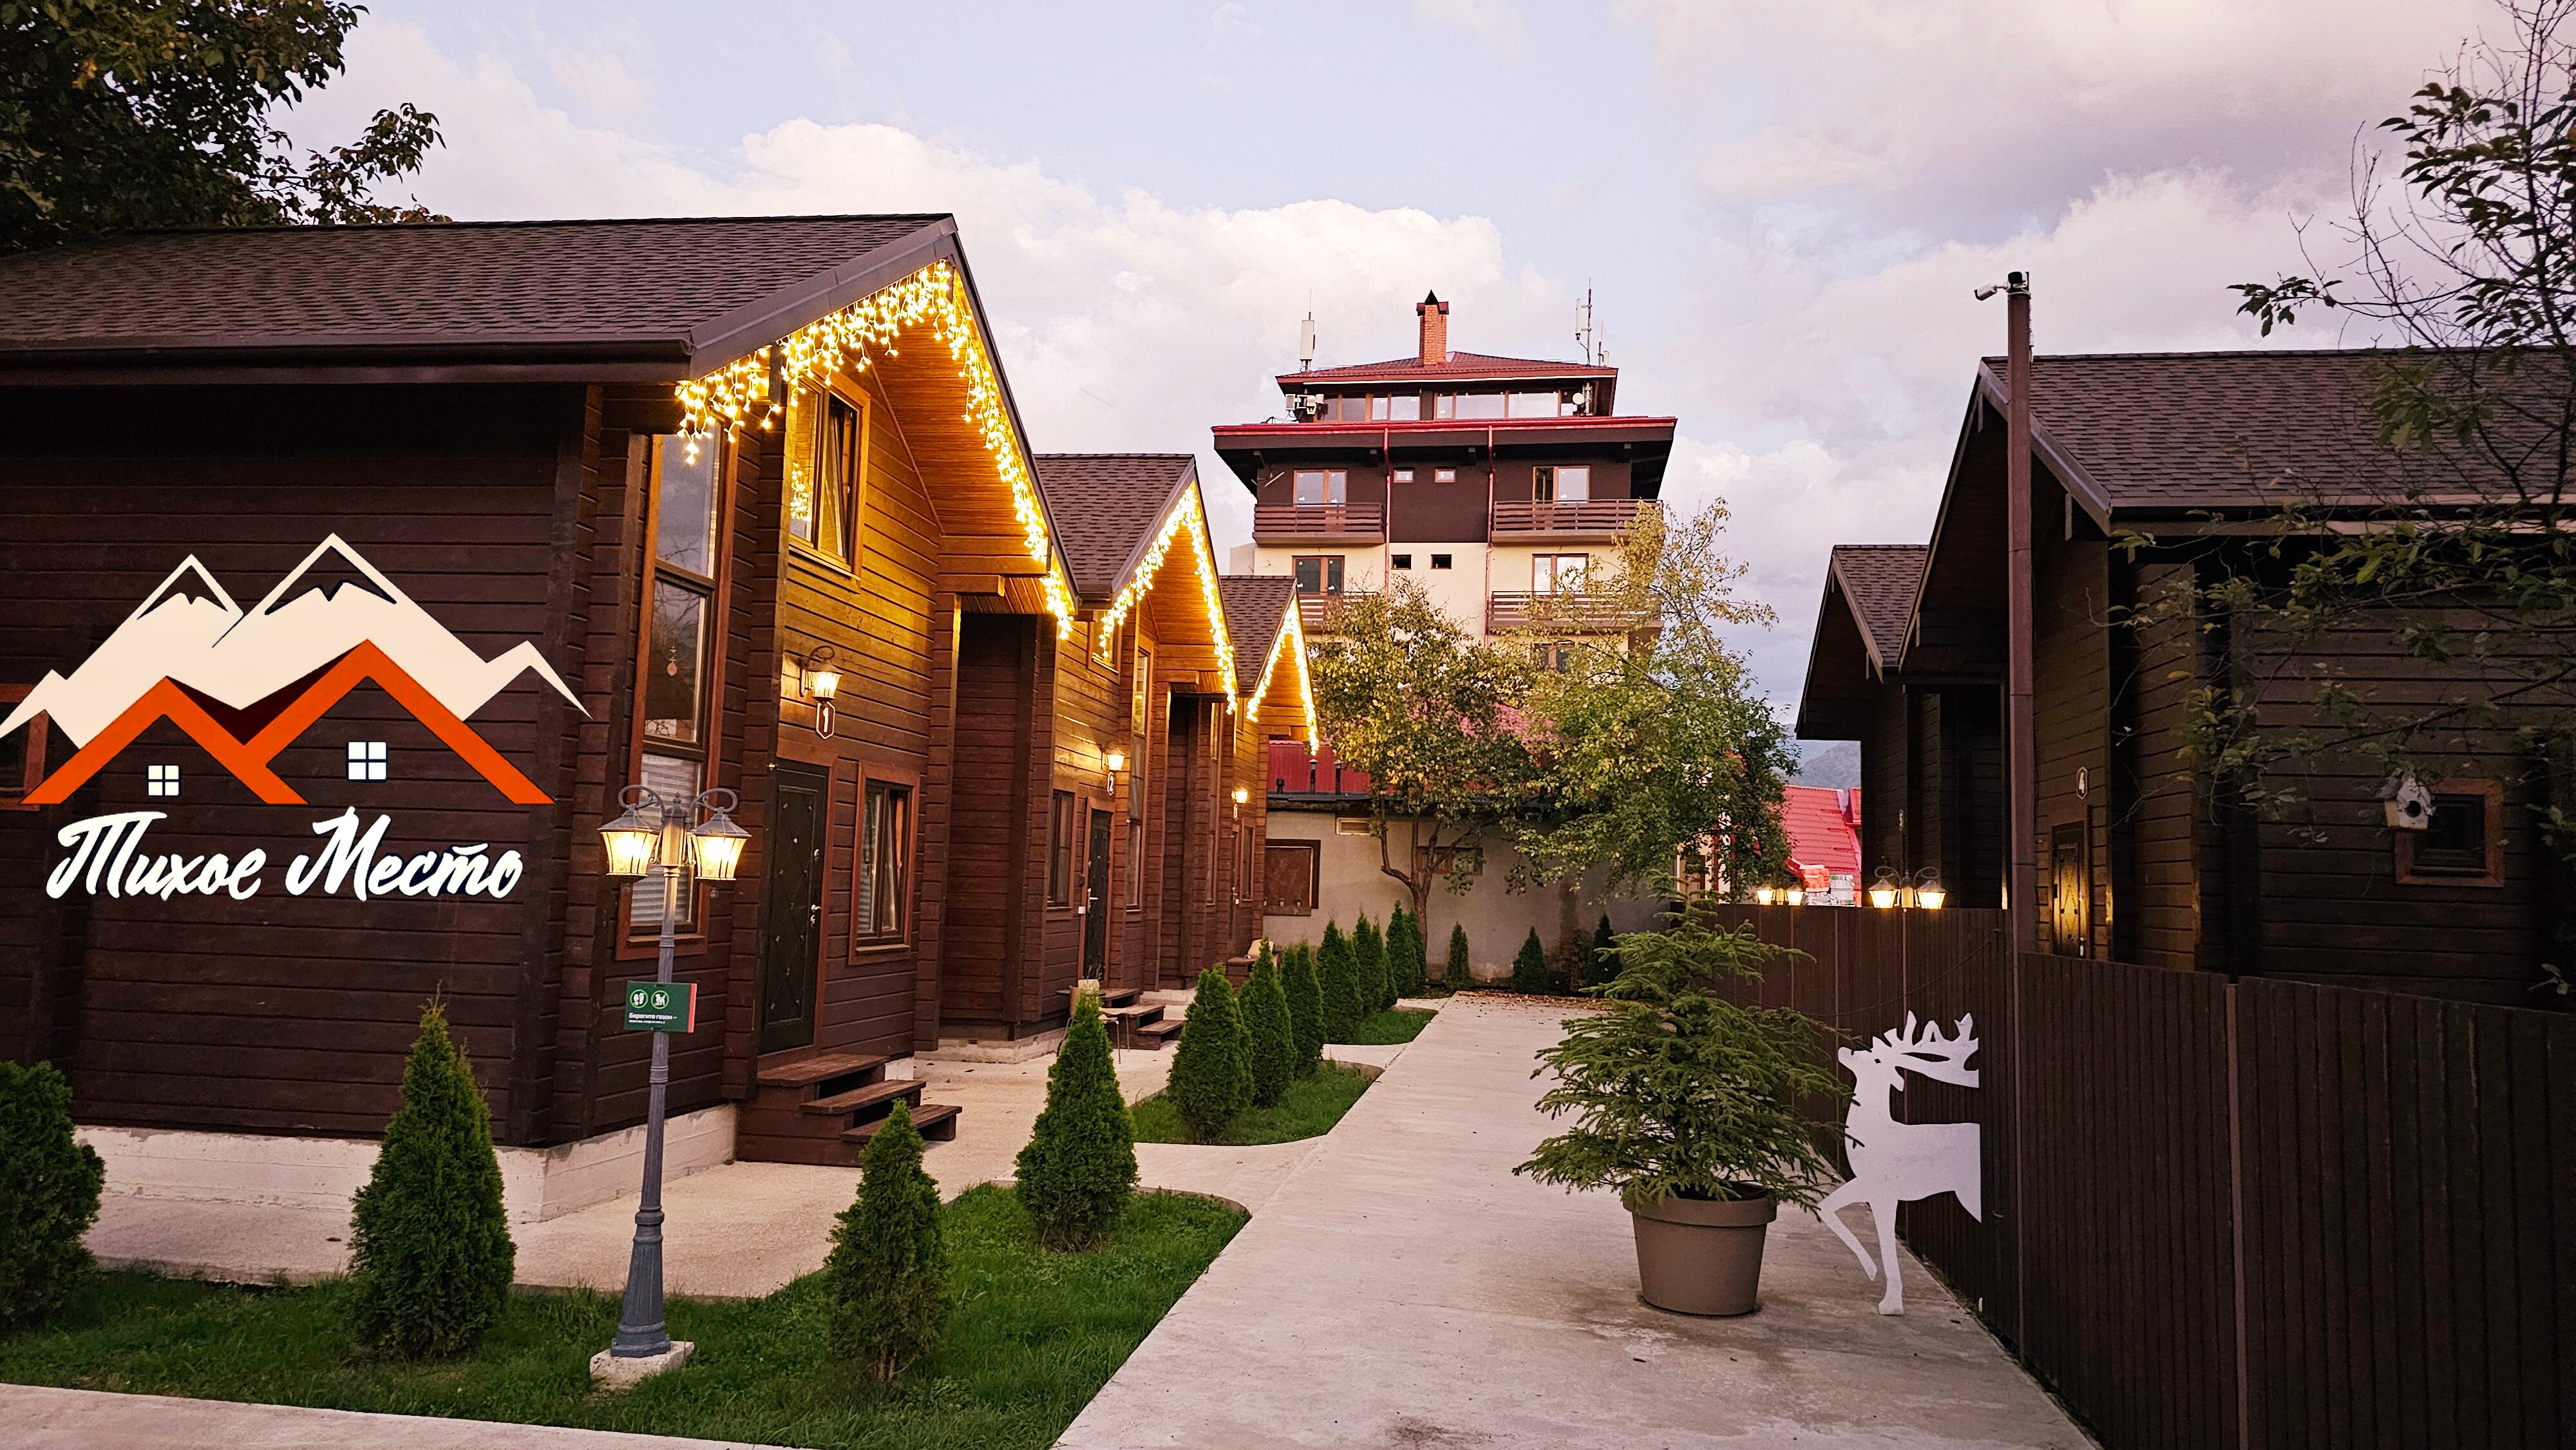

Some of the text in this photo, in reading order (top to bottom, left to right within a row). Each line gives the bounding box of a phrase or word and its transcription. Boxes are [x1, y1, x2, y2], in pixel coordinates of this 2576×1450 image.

[822, 707, 829, 733] 1
[1110, 775, 1113, 792] 2
[2079, 772, 2085, 794] 4
